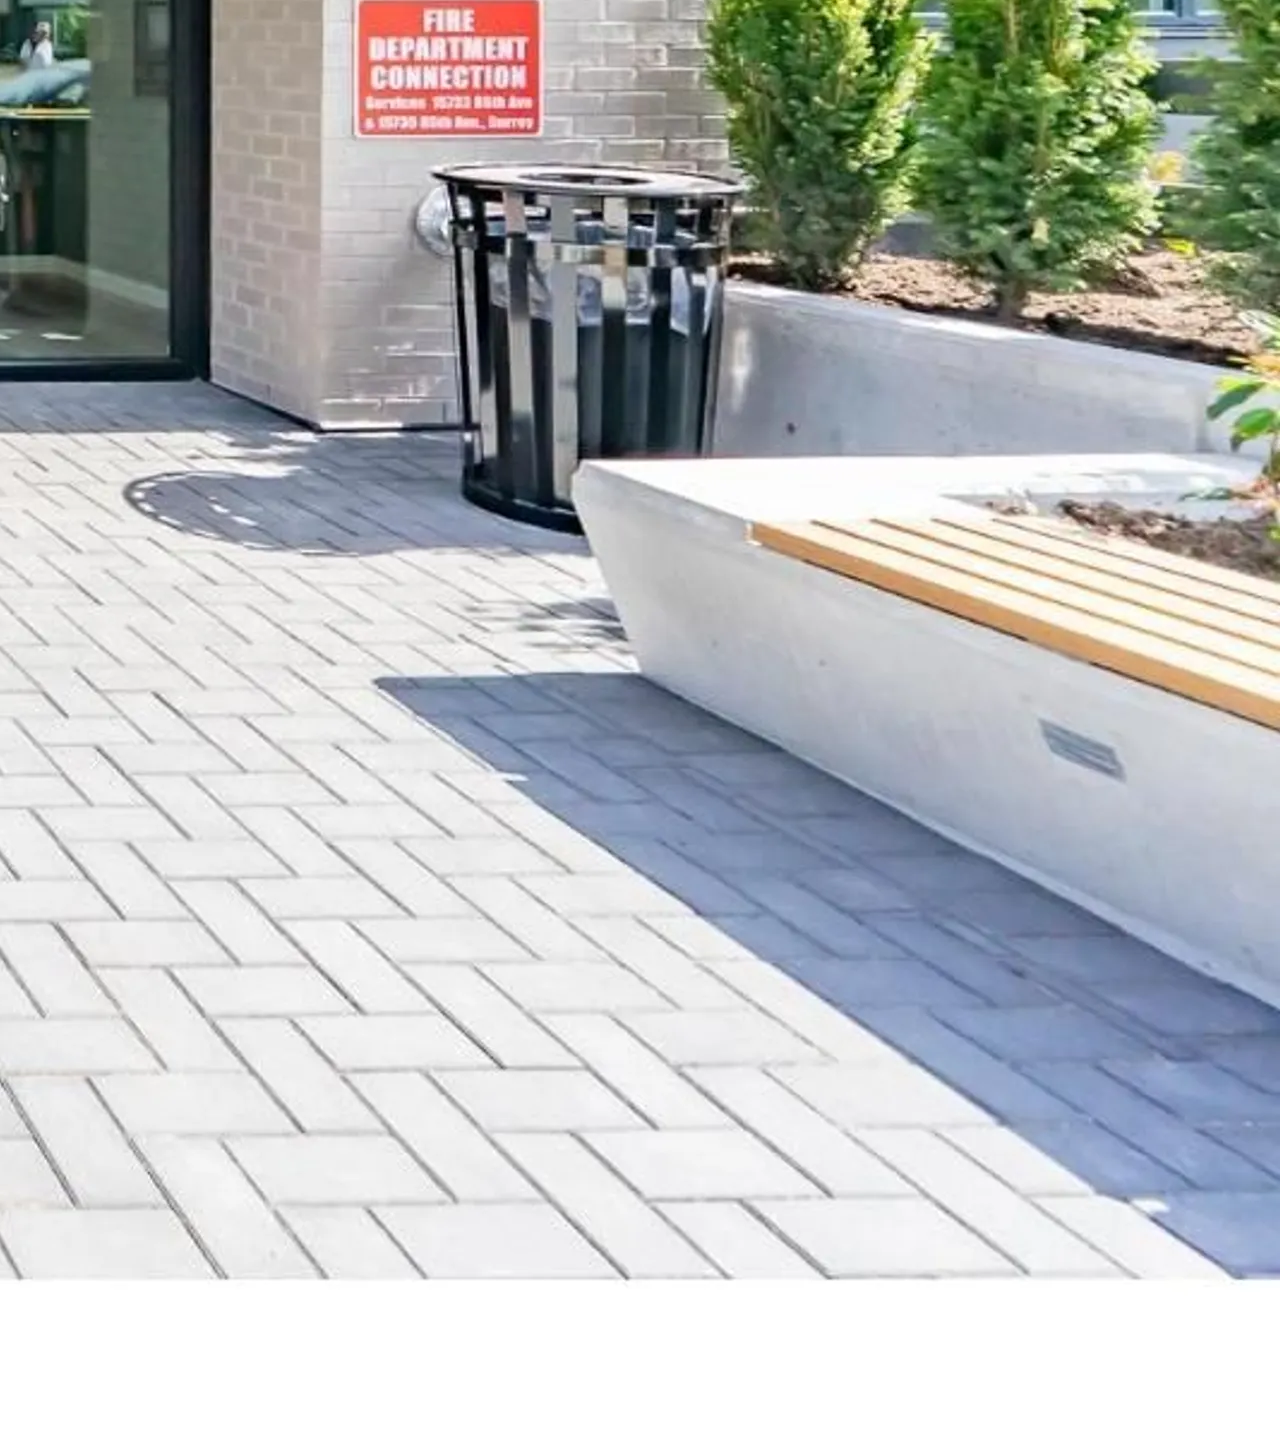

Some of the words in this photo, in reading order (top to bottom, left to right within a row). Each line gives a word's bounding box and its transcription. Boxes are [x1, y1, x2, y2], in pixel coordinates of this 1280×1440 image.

[423, 8, 475, 32] FIRE
[368, 37, 529, 60] DEPARTMENT
[371, 65, 527, 90] CONNECTION
